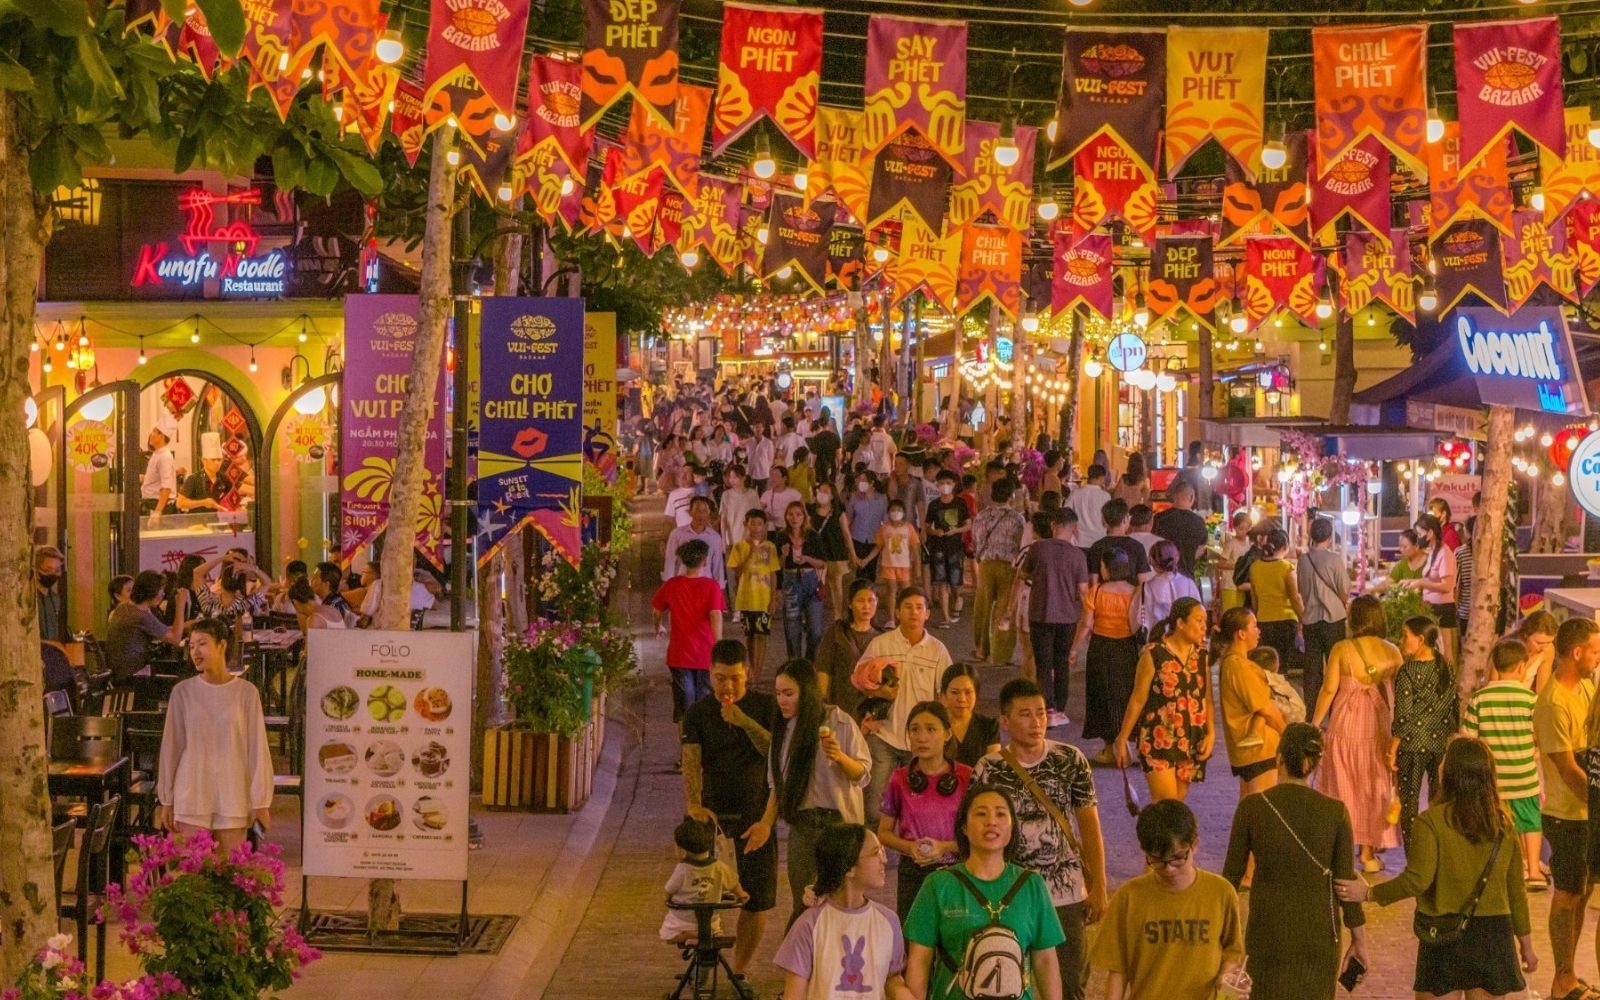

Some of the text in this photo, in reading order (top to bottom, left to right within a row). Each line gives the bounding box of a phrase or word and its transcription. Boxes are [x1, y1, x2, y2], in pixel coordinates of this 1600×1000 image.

[441, 25, 501, 51] BAZAAR
[606, 22, 662, 48] PHẾT
[747, 26, 796, 46] NGON
[896, 34, 938, 60] SAY
[1338, 37, 1393, 63] CHILL
[740, 44, 798, 73] PHẾT
[1188, 51, 1234, 75] VUI
[1473, 45, 1548, 72] VUI-FEST
[888, 57, 944, 83] PHẾT
[1335, 61, 1397, 89] PHẾT
[540, 79, 582, 101] VUI-FES
[1074, 78, 1147, 96] VUI-FEST
[1182, 74, 1242, 101] PHẾT
[1478, 81, 1544, 106] BAZAAR
[536, 104, 580, 128] BAZAAR
[825, 123, 857, 143] VUI
[884, 160, 938, 177] VUI-FEST
[700, 185, 725, 201] SAY
[1324, 177, 1375, 195] BAZAAR
[779, 227, 822, 244] VUI-FEST
[1521, 222, 1547, 240] SAY
[976, 235, 1008, 248] CHILL
[1061, 248, 1105, 266] VUI-FEST
[1166, 246, 1198, 263] ĐẸP
[1263, 249, 1296, 261] NGON
[1442, 252, 1489, 267] VUI-FEST
[130, 242, 285, 288] Kungfu Noodle
[223, 279, 284, 292] Restaurant
[1063, 271, 1102, 287] BAZAAR
[370, 340, 415, 352] VUI-FES
[507, 342, 558, 354] VUI-FEST
[1457, 316, 1561, 380] Coconut
[511, 373, 552, 399] CHỢ
[350, 400, 387, 418] VUI
[485, 398, 529, 419] CHILL
[533, 399, 577, 419] PHẾT
[75, 443, 99, 455] 40K
[1435, 482, 1478, 491] Yakult
[356, 669, 422, 680] HOME-MADE
[1144, 917, 1211, 946] STATE
